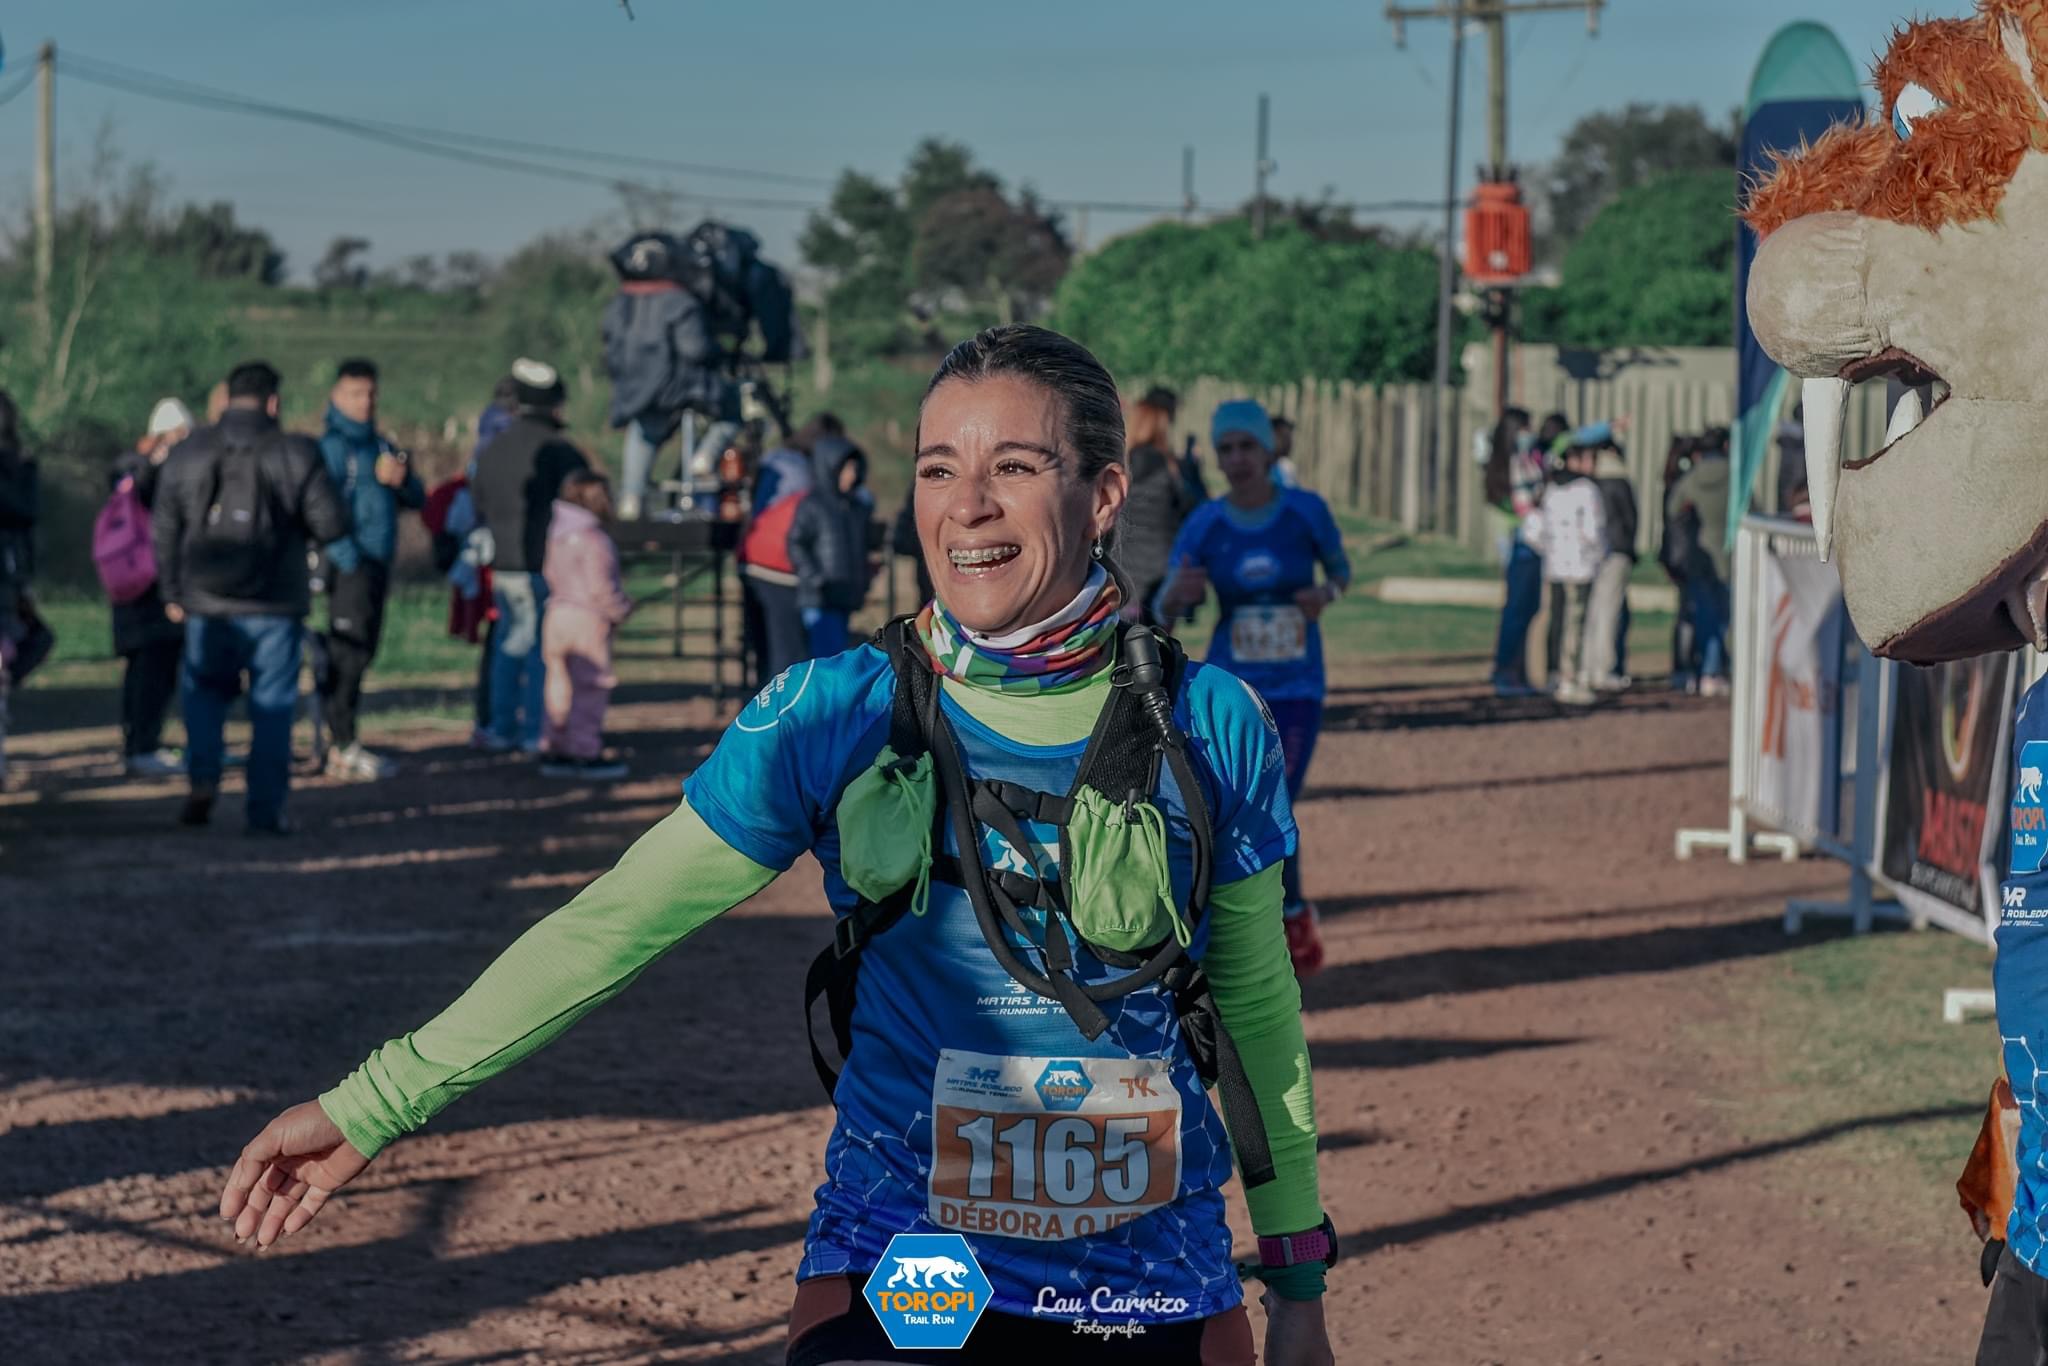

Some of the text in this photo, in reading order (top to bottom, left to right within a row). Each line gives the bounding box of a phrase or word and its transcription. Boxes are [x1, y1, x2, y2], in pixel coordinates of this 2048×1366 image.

[976, 996, 1032, 1006] MATIAS
[999, 1007, 1048, 1016] RUNNING
[1042, 1085, 1088, 1096] TOROPI
[1119, 1077, 1159, 1099] 7K
[956, 1115, 1151, 1205] 1165
[939, 1200, 1065, 1239] DÉBORA
